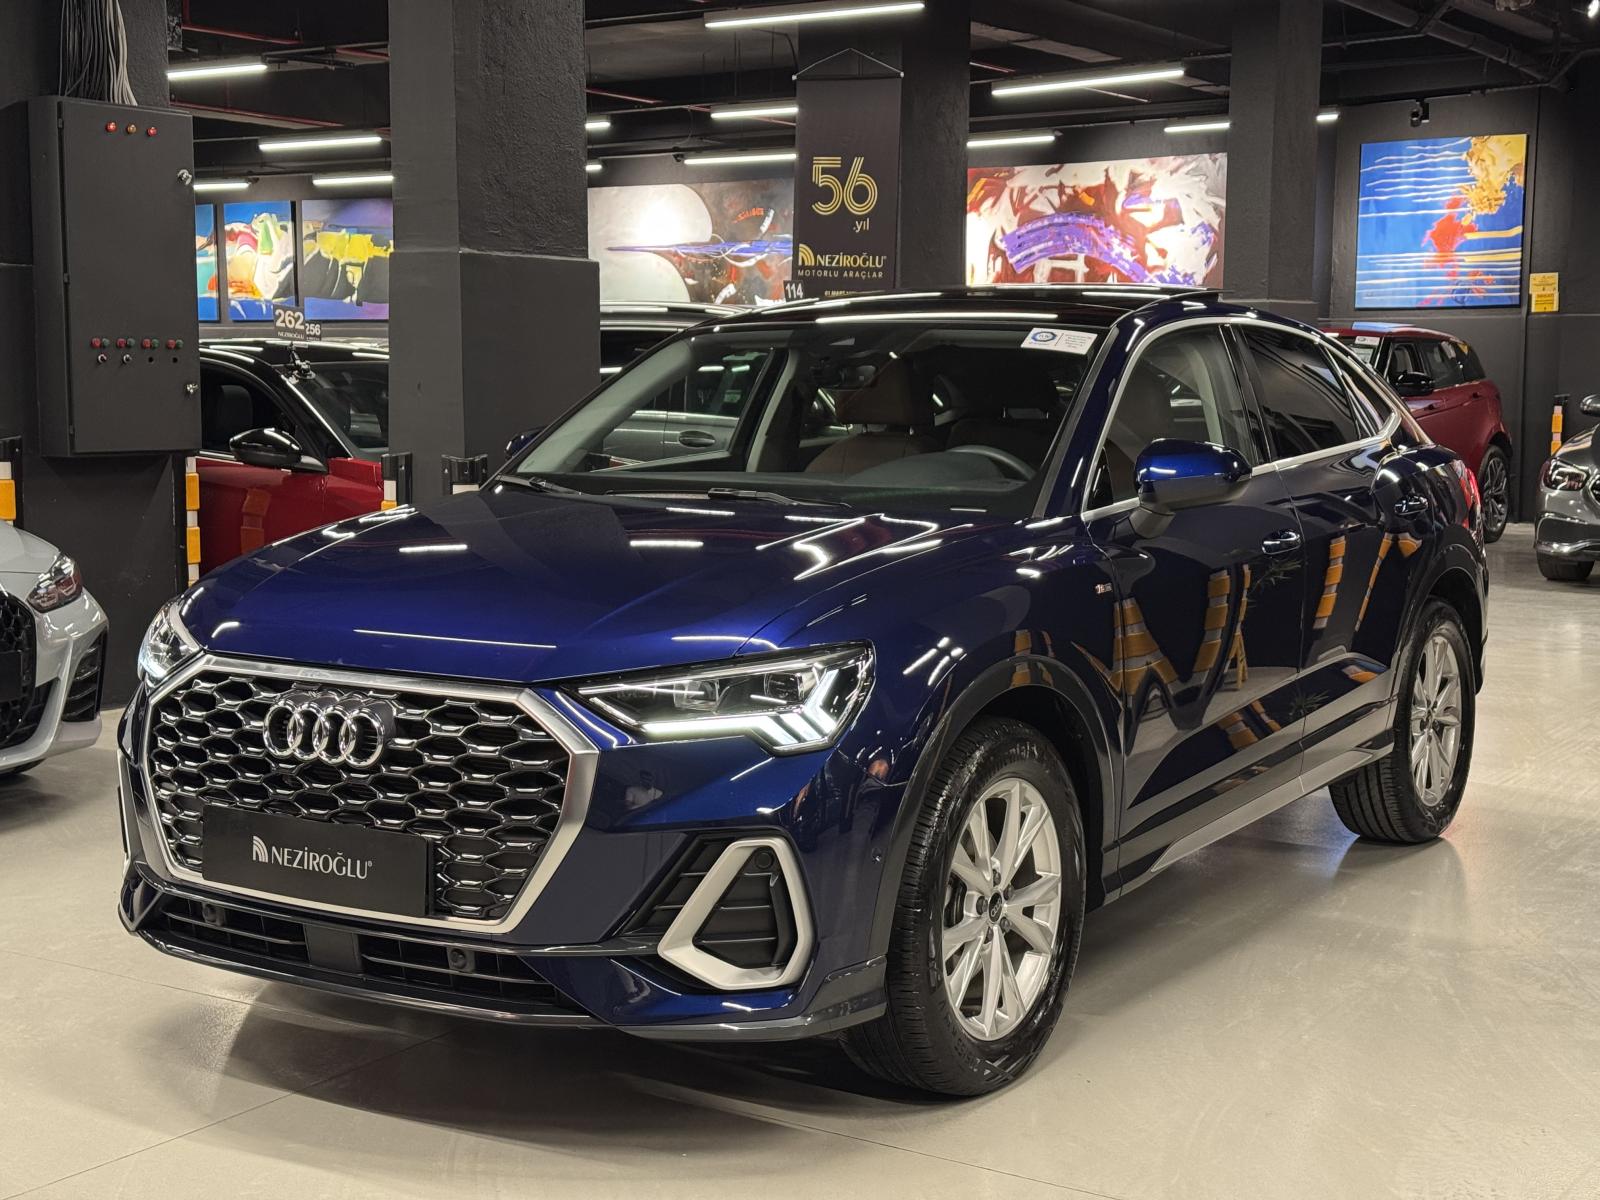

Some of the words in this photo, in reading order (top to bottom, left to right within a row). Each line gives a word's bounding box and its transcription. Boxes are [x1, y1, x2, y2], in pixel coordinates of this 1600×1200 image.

[812, 156, 878, 215] 56
[816, 252, 884, 268] NEZİROĞLU
[798, 269, 839, 278] MOTORLU
[843, 271, 884, 280] ARAÇLAR
[785, 283, 804, 299] 114
[275, 309, 305, 330] 262
[305, 323, 321, 336] 256
[271, 845, 369, 880] NEZİROĞLU
